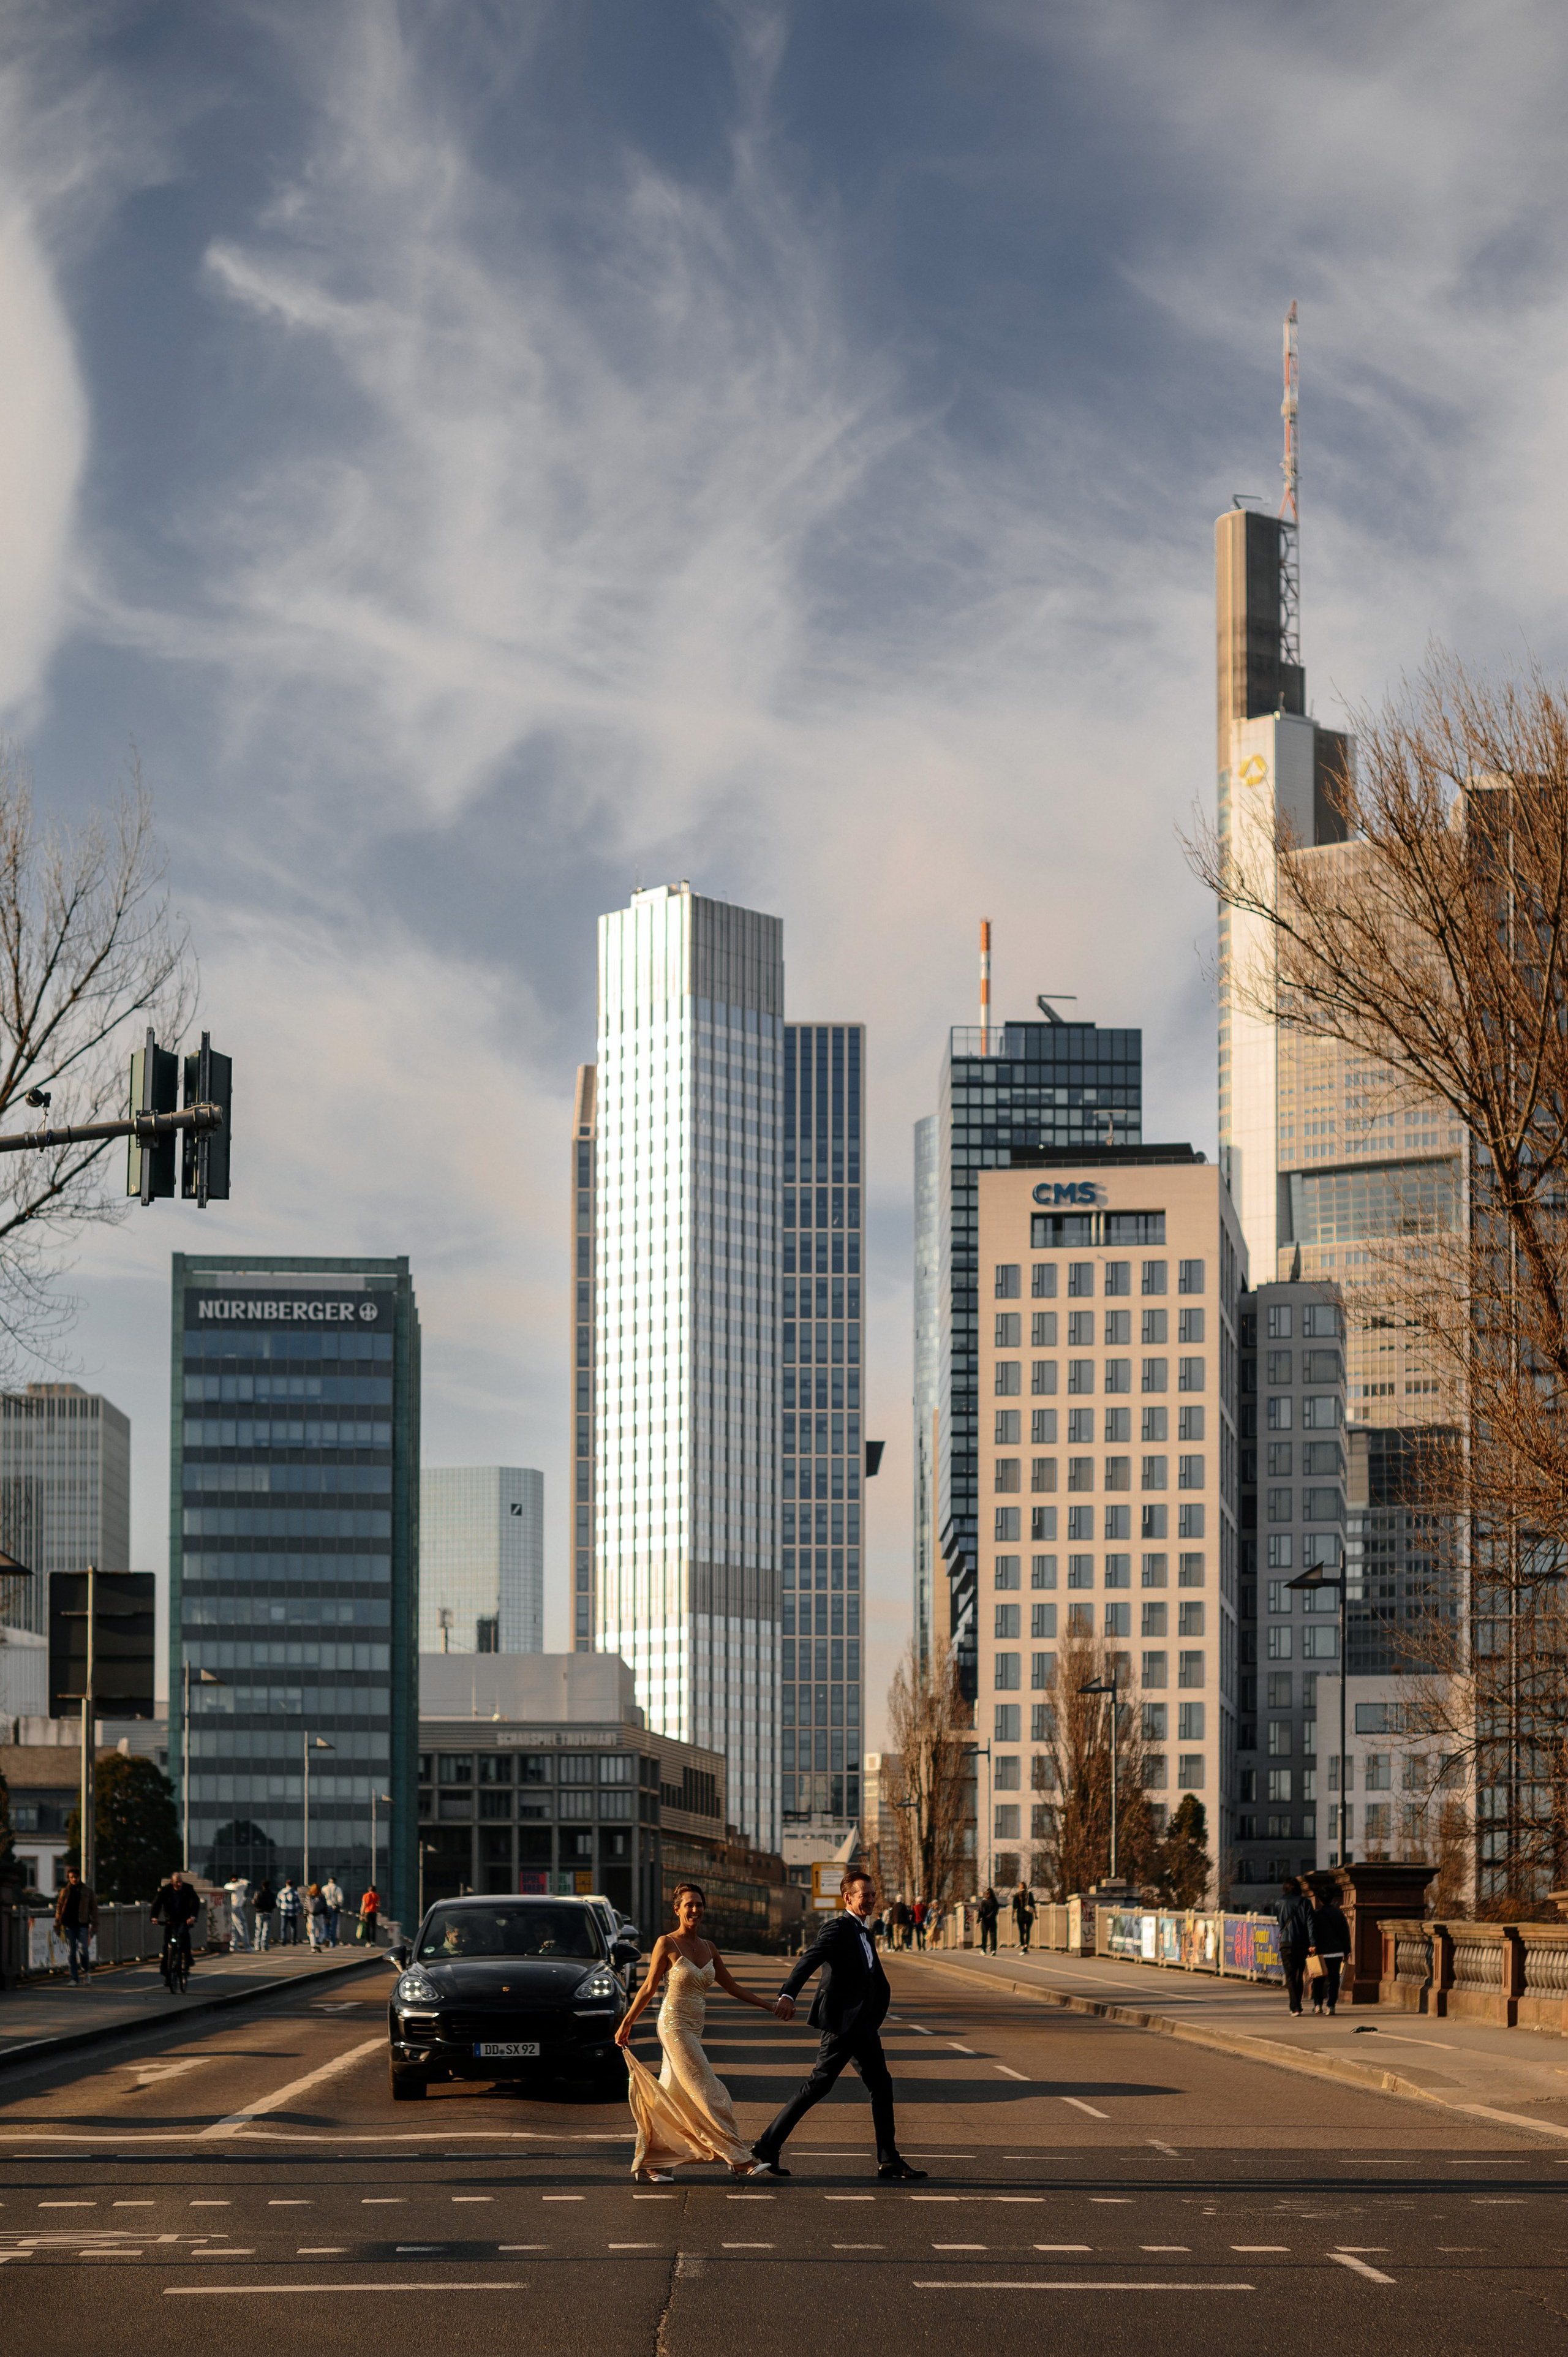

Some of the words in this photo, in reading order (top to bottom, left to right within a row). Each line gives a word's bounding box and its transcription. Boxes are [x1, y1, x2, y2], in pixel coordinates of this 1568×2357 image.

[1032, 1181, 1097, 1205] CMS
[198, 1299, 355, 1321] NÜRNBERGER
[484, 2045, 499, 2054] DD
[506, 2045, 519, 2054] SX
[522, 2044, 535, 2054] 92
